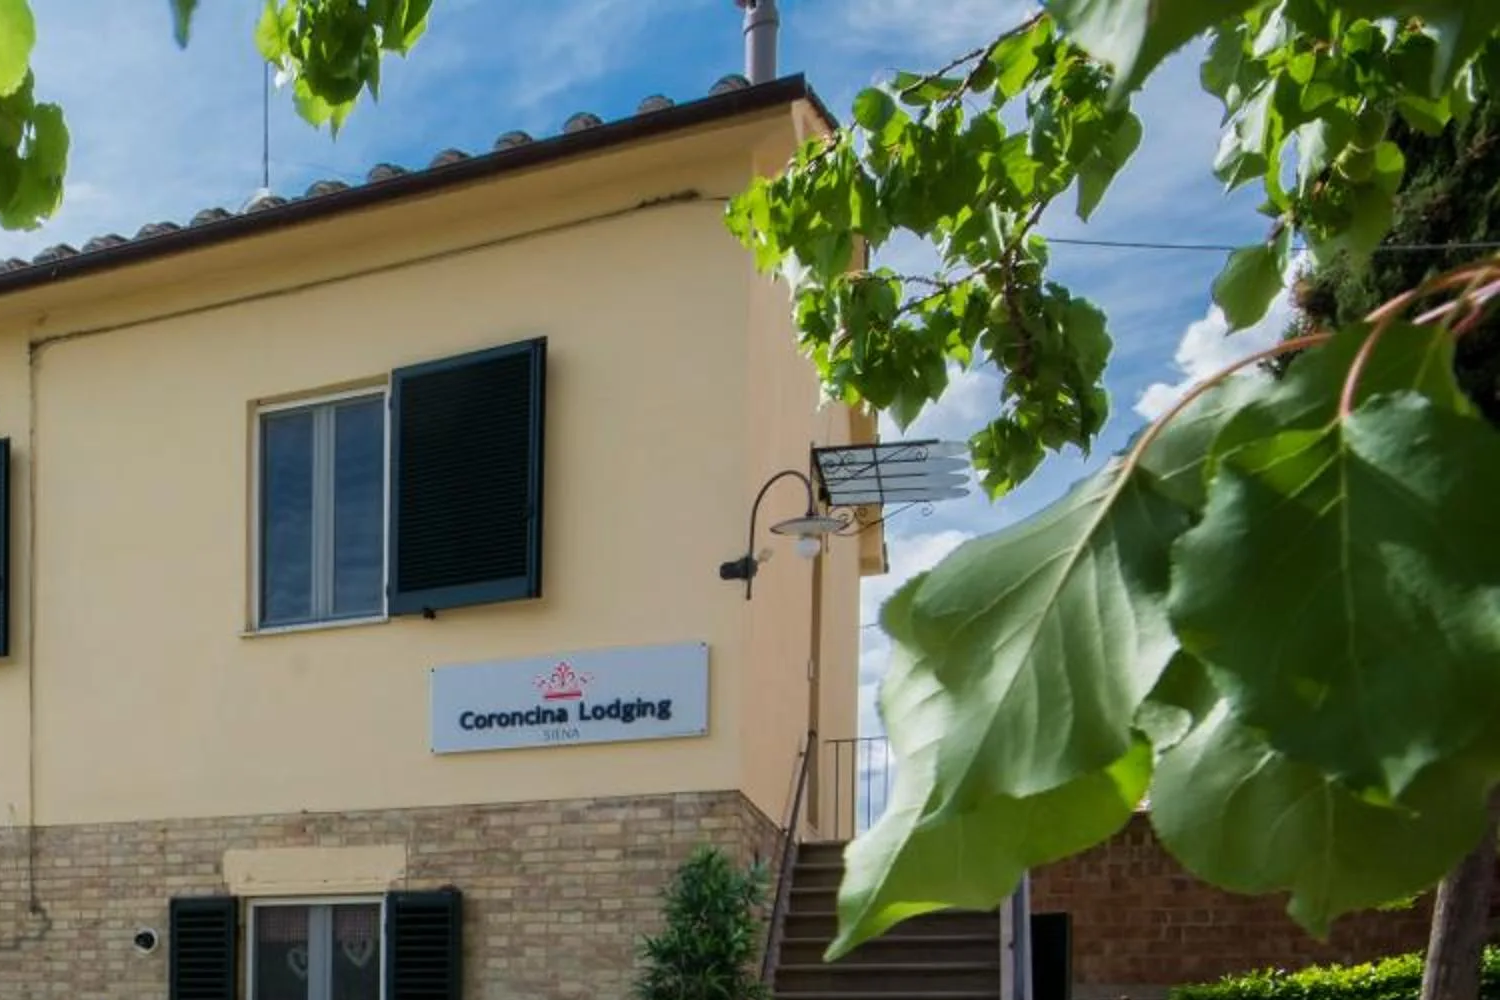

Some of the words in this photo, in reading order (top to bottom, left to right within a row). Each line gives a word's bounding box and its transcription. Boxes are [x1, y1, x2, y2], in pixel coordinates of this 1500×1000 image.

[459, 705, 569, 730] Coroncina
[579, 698, 672, 723] Lodging
[543, 727, 580, 741] SIENA
